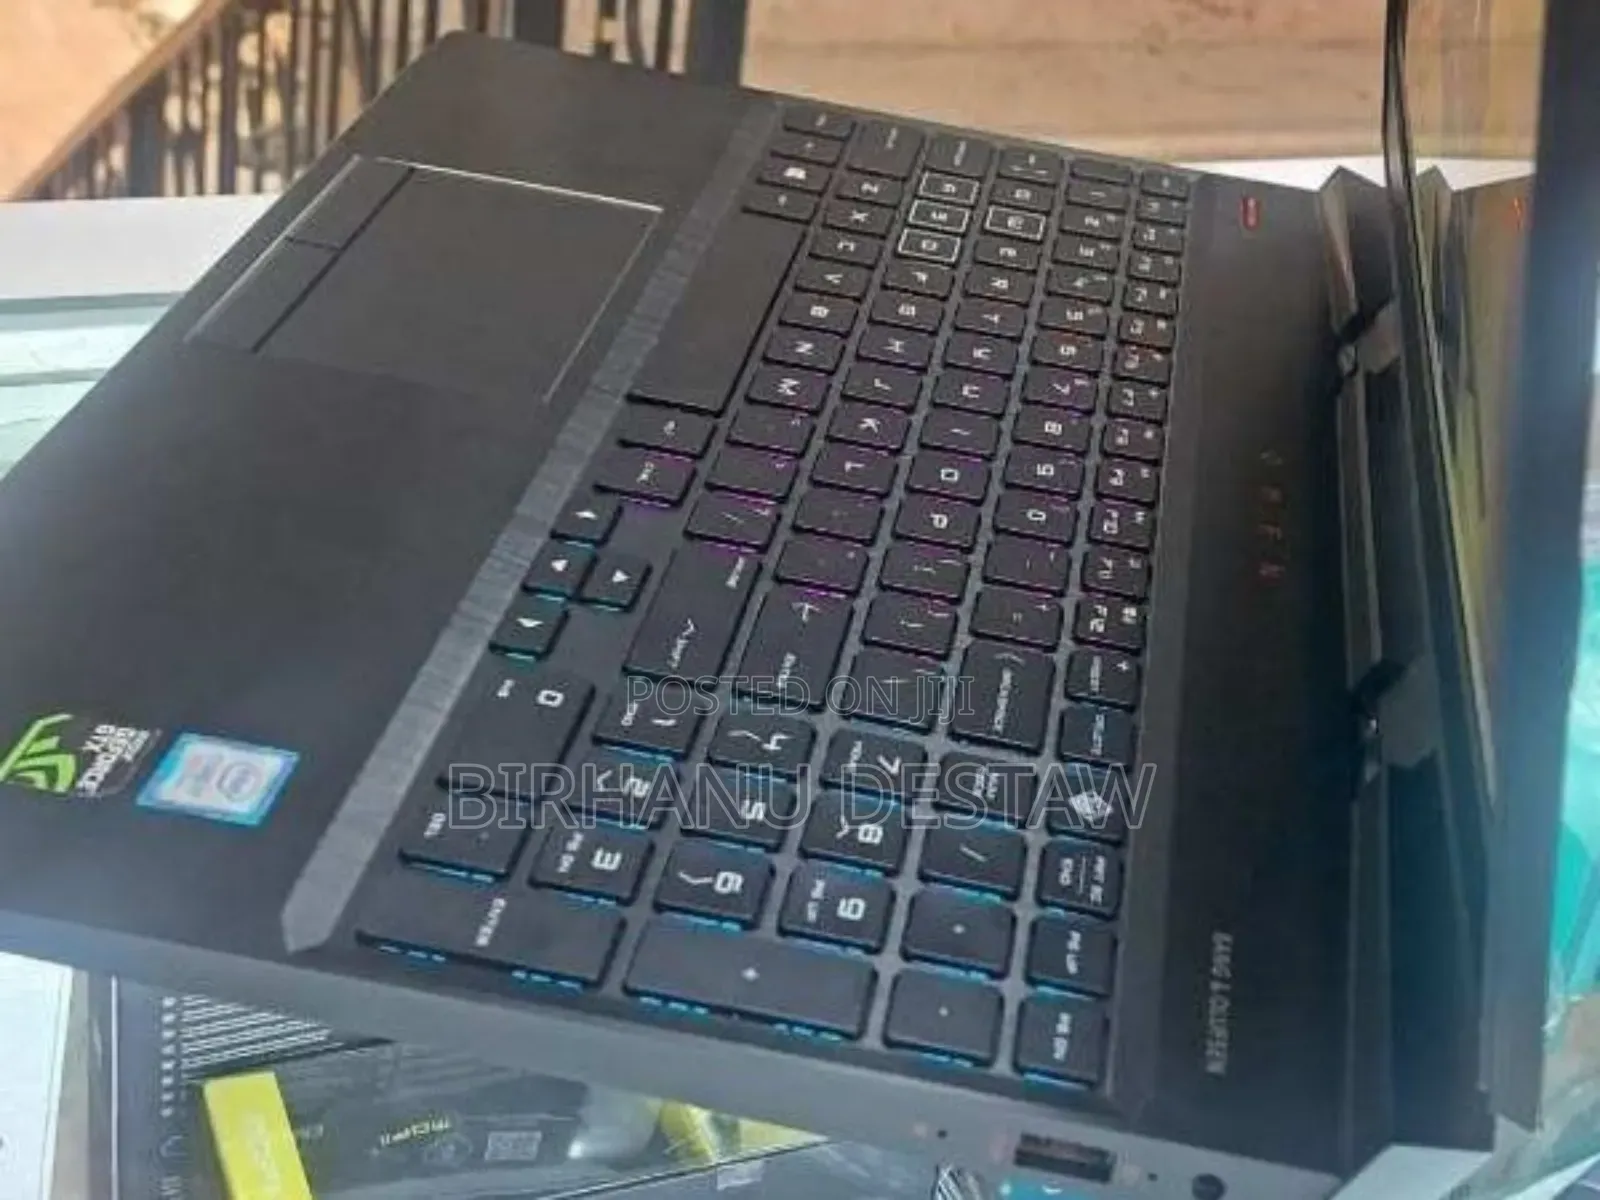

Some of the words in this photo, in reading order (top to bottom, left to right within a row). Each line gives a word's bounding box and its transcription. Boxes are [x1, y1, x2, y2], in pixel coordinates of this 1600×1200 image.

[861, 182, 878, 193] Z
[849, 211, 869, 223] X
[1084, 215, 1101, 225] 2
[838, 240, 855, 252] C
[998, 246, 1016, 258] E
[823, 272, 842, 284] V
[913, 271, 927, 285] F
[991, 277, 1009, 290] R
[810, 305, 829, 318] B
[981, 312, 999, 324] T
[1066, 309, 1084, 322] 5
[794, 340, 813, 355] N
[885, 338, 905, 352] H
[777, 378, 800, 395] M
[961, 385, 981, 399] U
[1052, 383, 1071, 396] 7
[859, 417, 879, 434] K
[1044, 421, 1063, 436] 8
[844, 460, 865, 473] L
[1035, 463, 1055, 477] 9
[927, 512, 950, 530] P
[1089, 603, 1108, 633] F12
[534, 688, 566, 709] 0
[82, 724, 117, 754] GTX
[762, 733, 790, 752] 4
[875, 753, 903, 776] 7
[619, 775, 651, 800] 2
[739, 800, 766, 822] 5
[421, 811, 448, 840] DEL
[856, 823, 885, 845] 8
[589, 846, 624, 872] 3
[712, 869, 745, 896] 6
[835, 897, 866, 921] 9
[472, 896, 508, 948] ENTER
